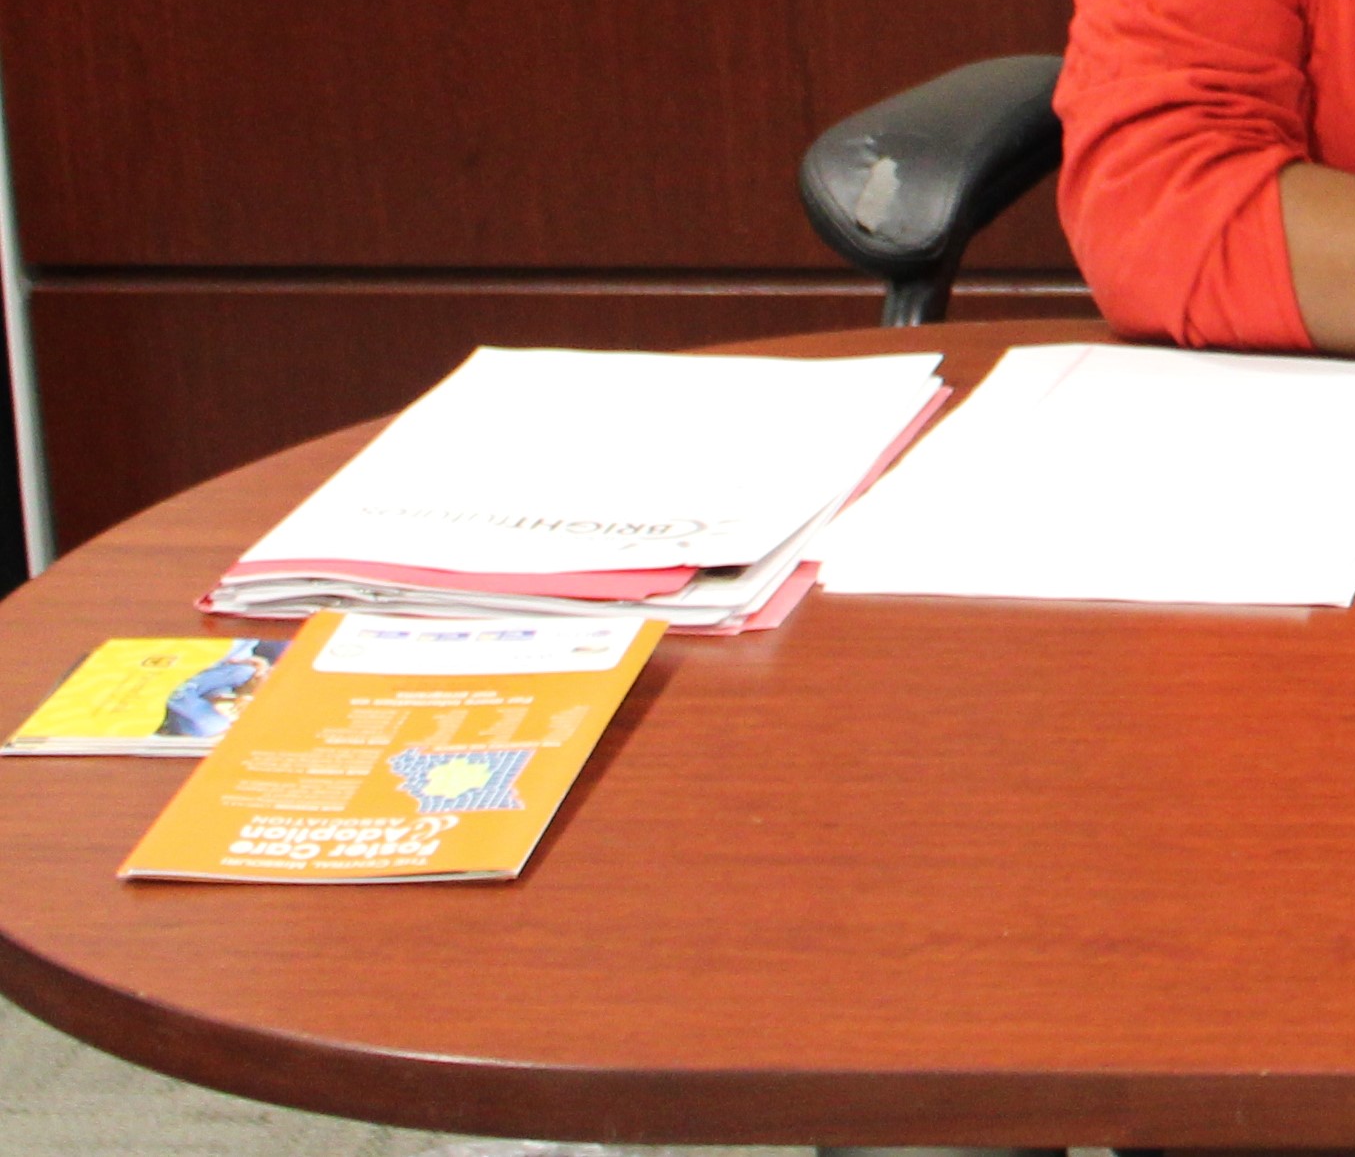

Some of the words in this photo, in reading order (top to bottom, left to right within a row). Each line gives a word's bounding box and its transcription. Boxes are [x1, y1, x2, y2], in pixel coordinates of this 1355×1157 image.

[251, 816, 406, 827] ASSOCIATION
[239, 825, 411, 844] Adoption
[228, 840, 321, 860] Care
[328, 840, 440, 859] Foster
